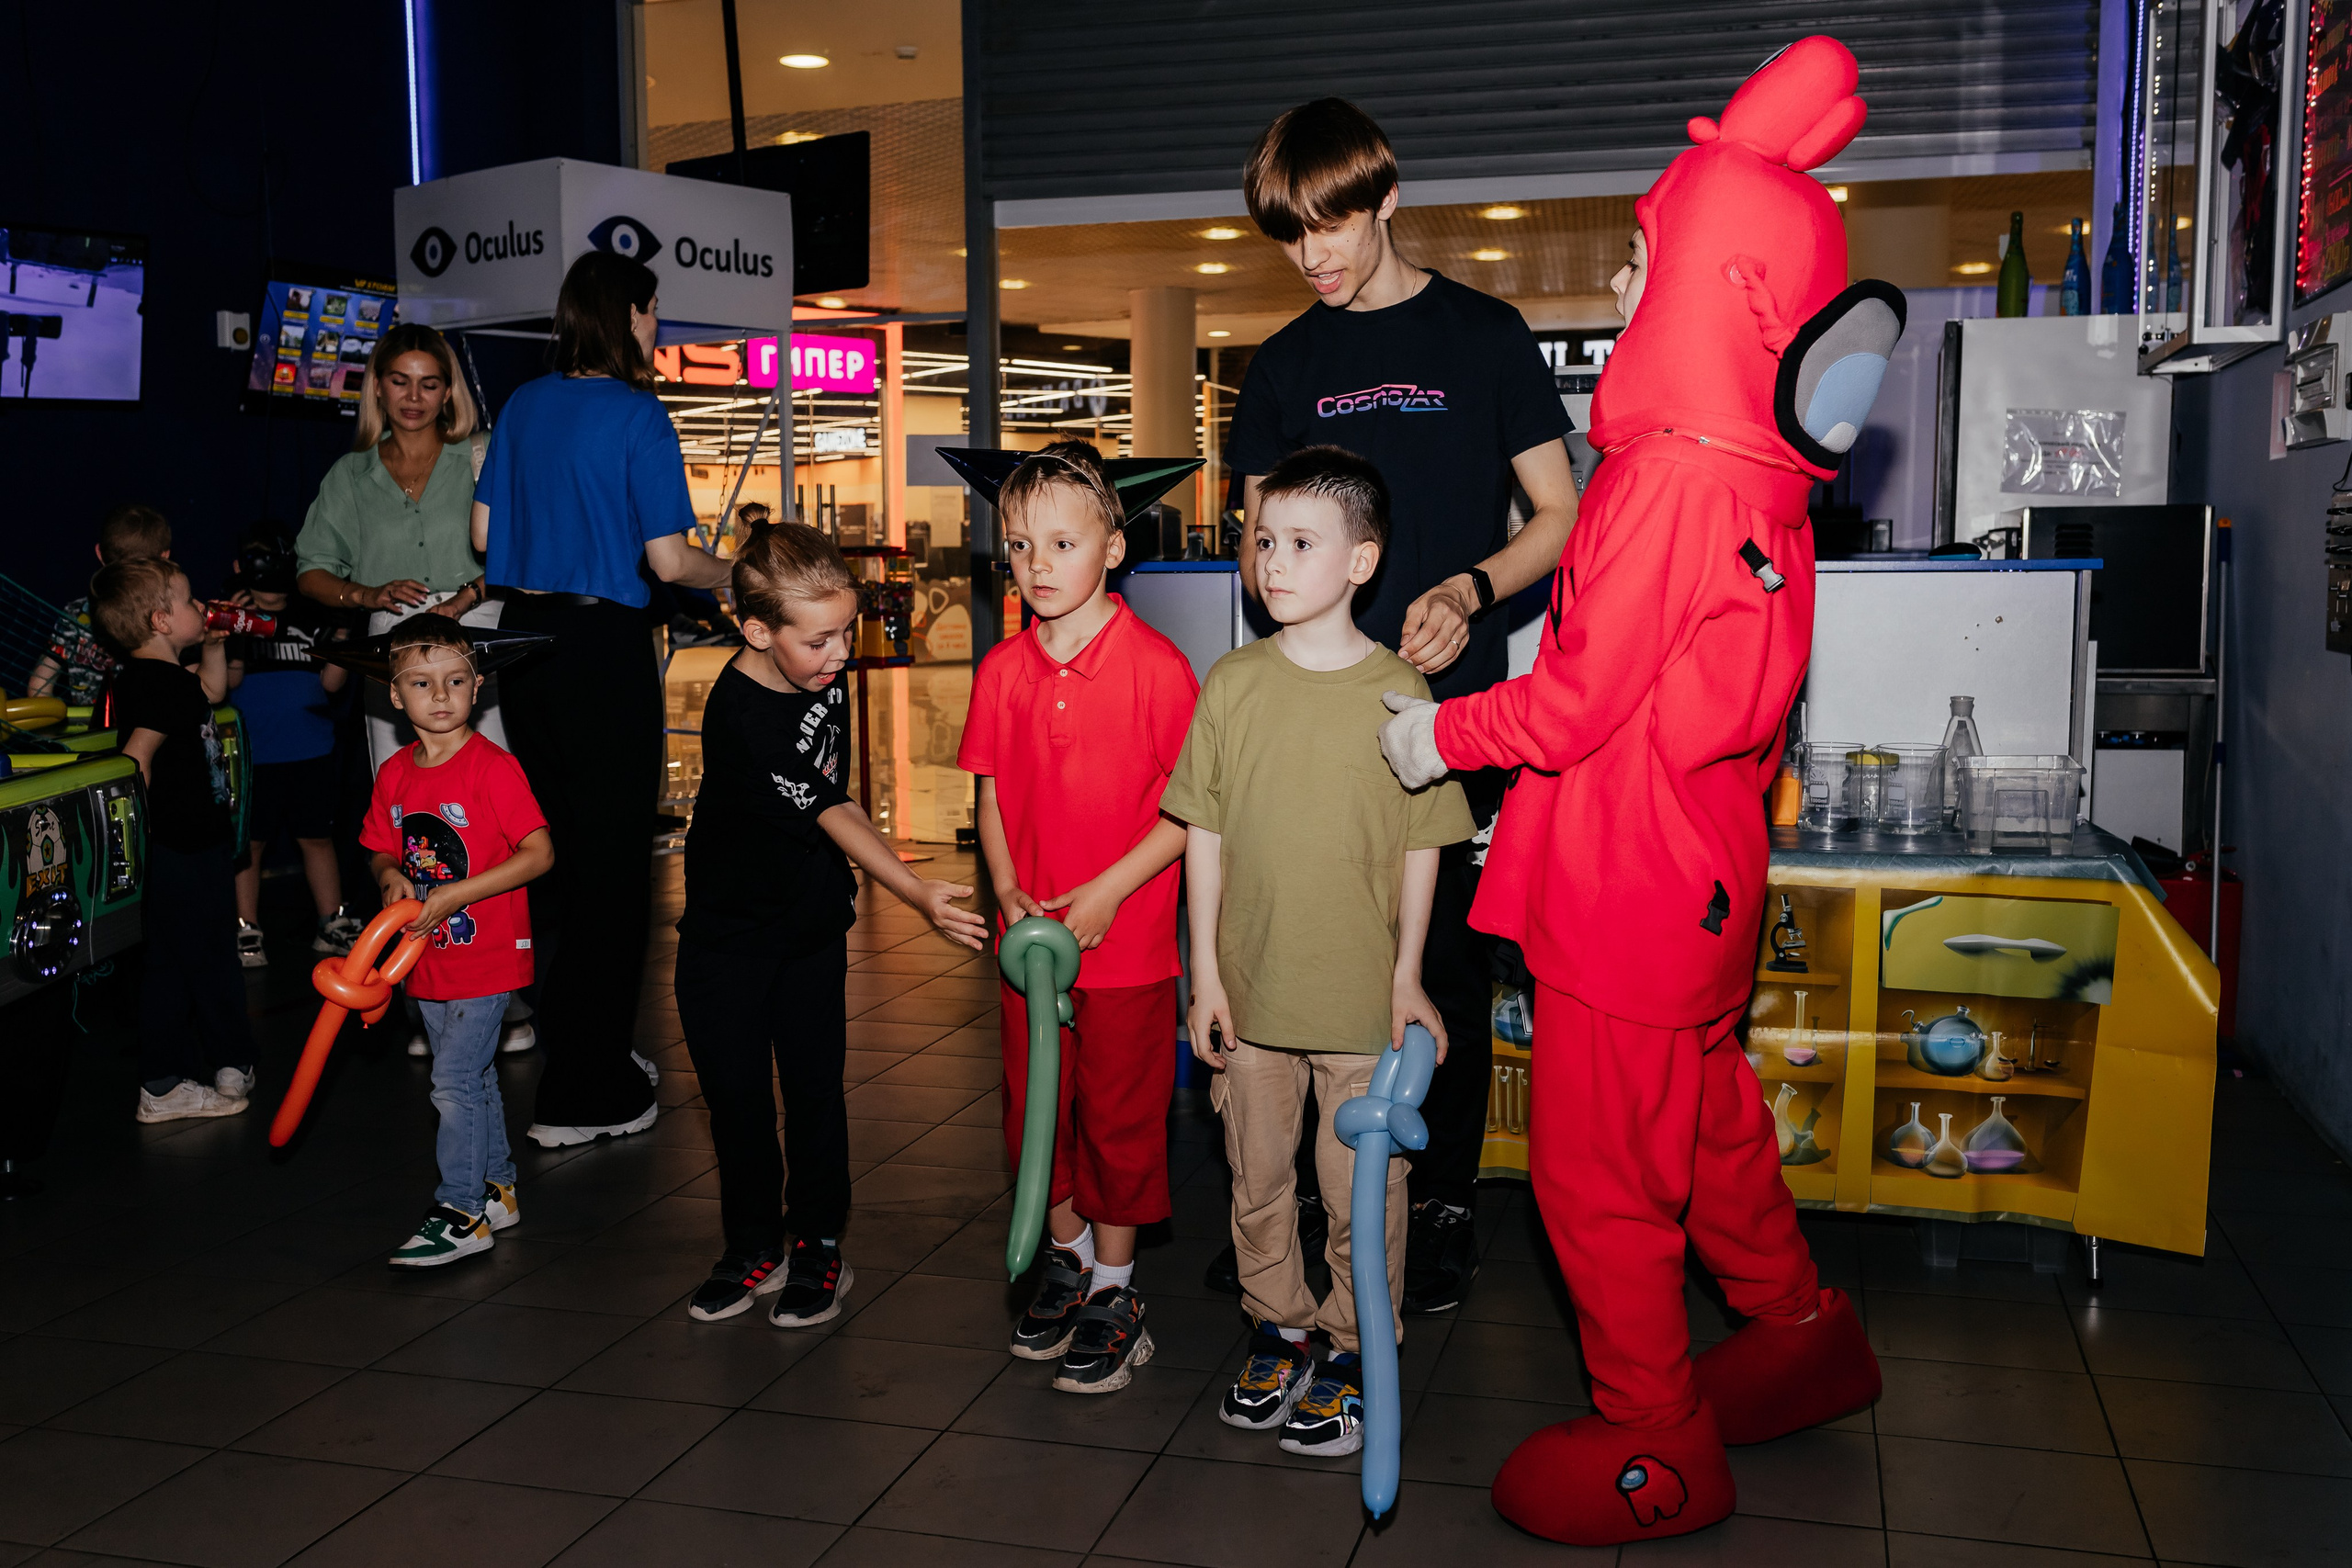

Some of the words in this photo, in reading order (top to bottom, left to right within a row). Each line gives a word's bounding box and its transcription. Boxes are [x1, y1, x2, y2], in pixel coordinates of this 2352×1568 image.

[465, 220, 544, 265] Oculus
[675, 237, 774, 277] Oculus
[654, 340, 742, 387] NS
[796, 703, 829, 754] NVER
[26, 863, 68, 899] EXIT
